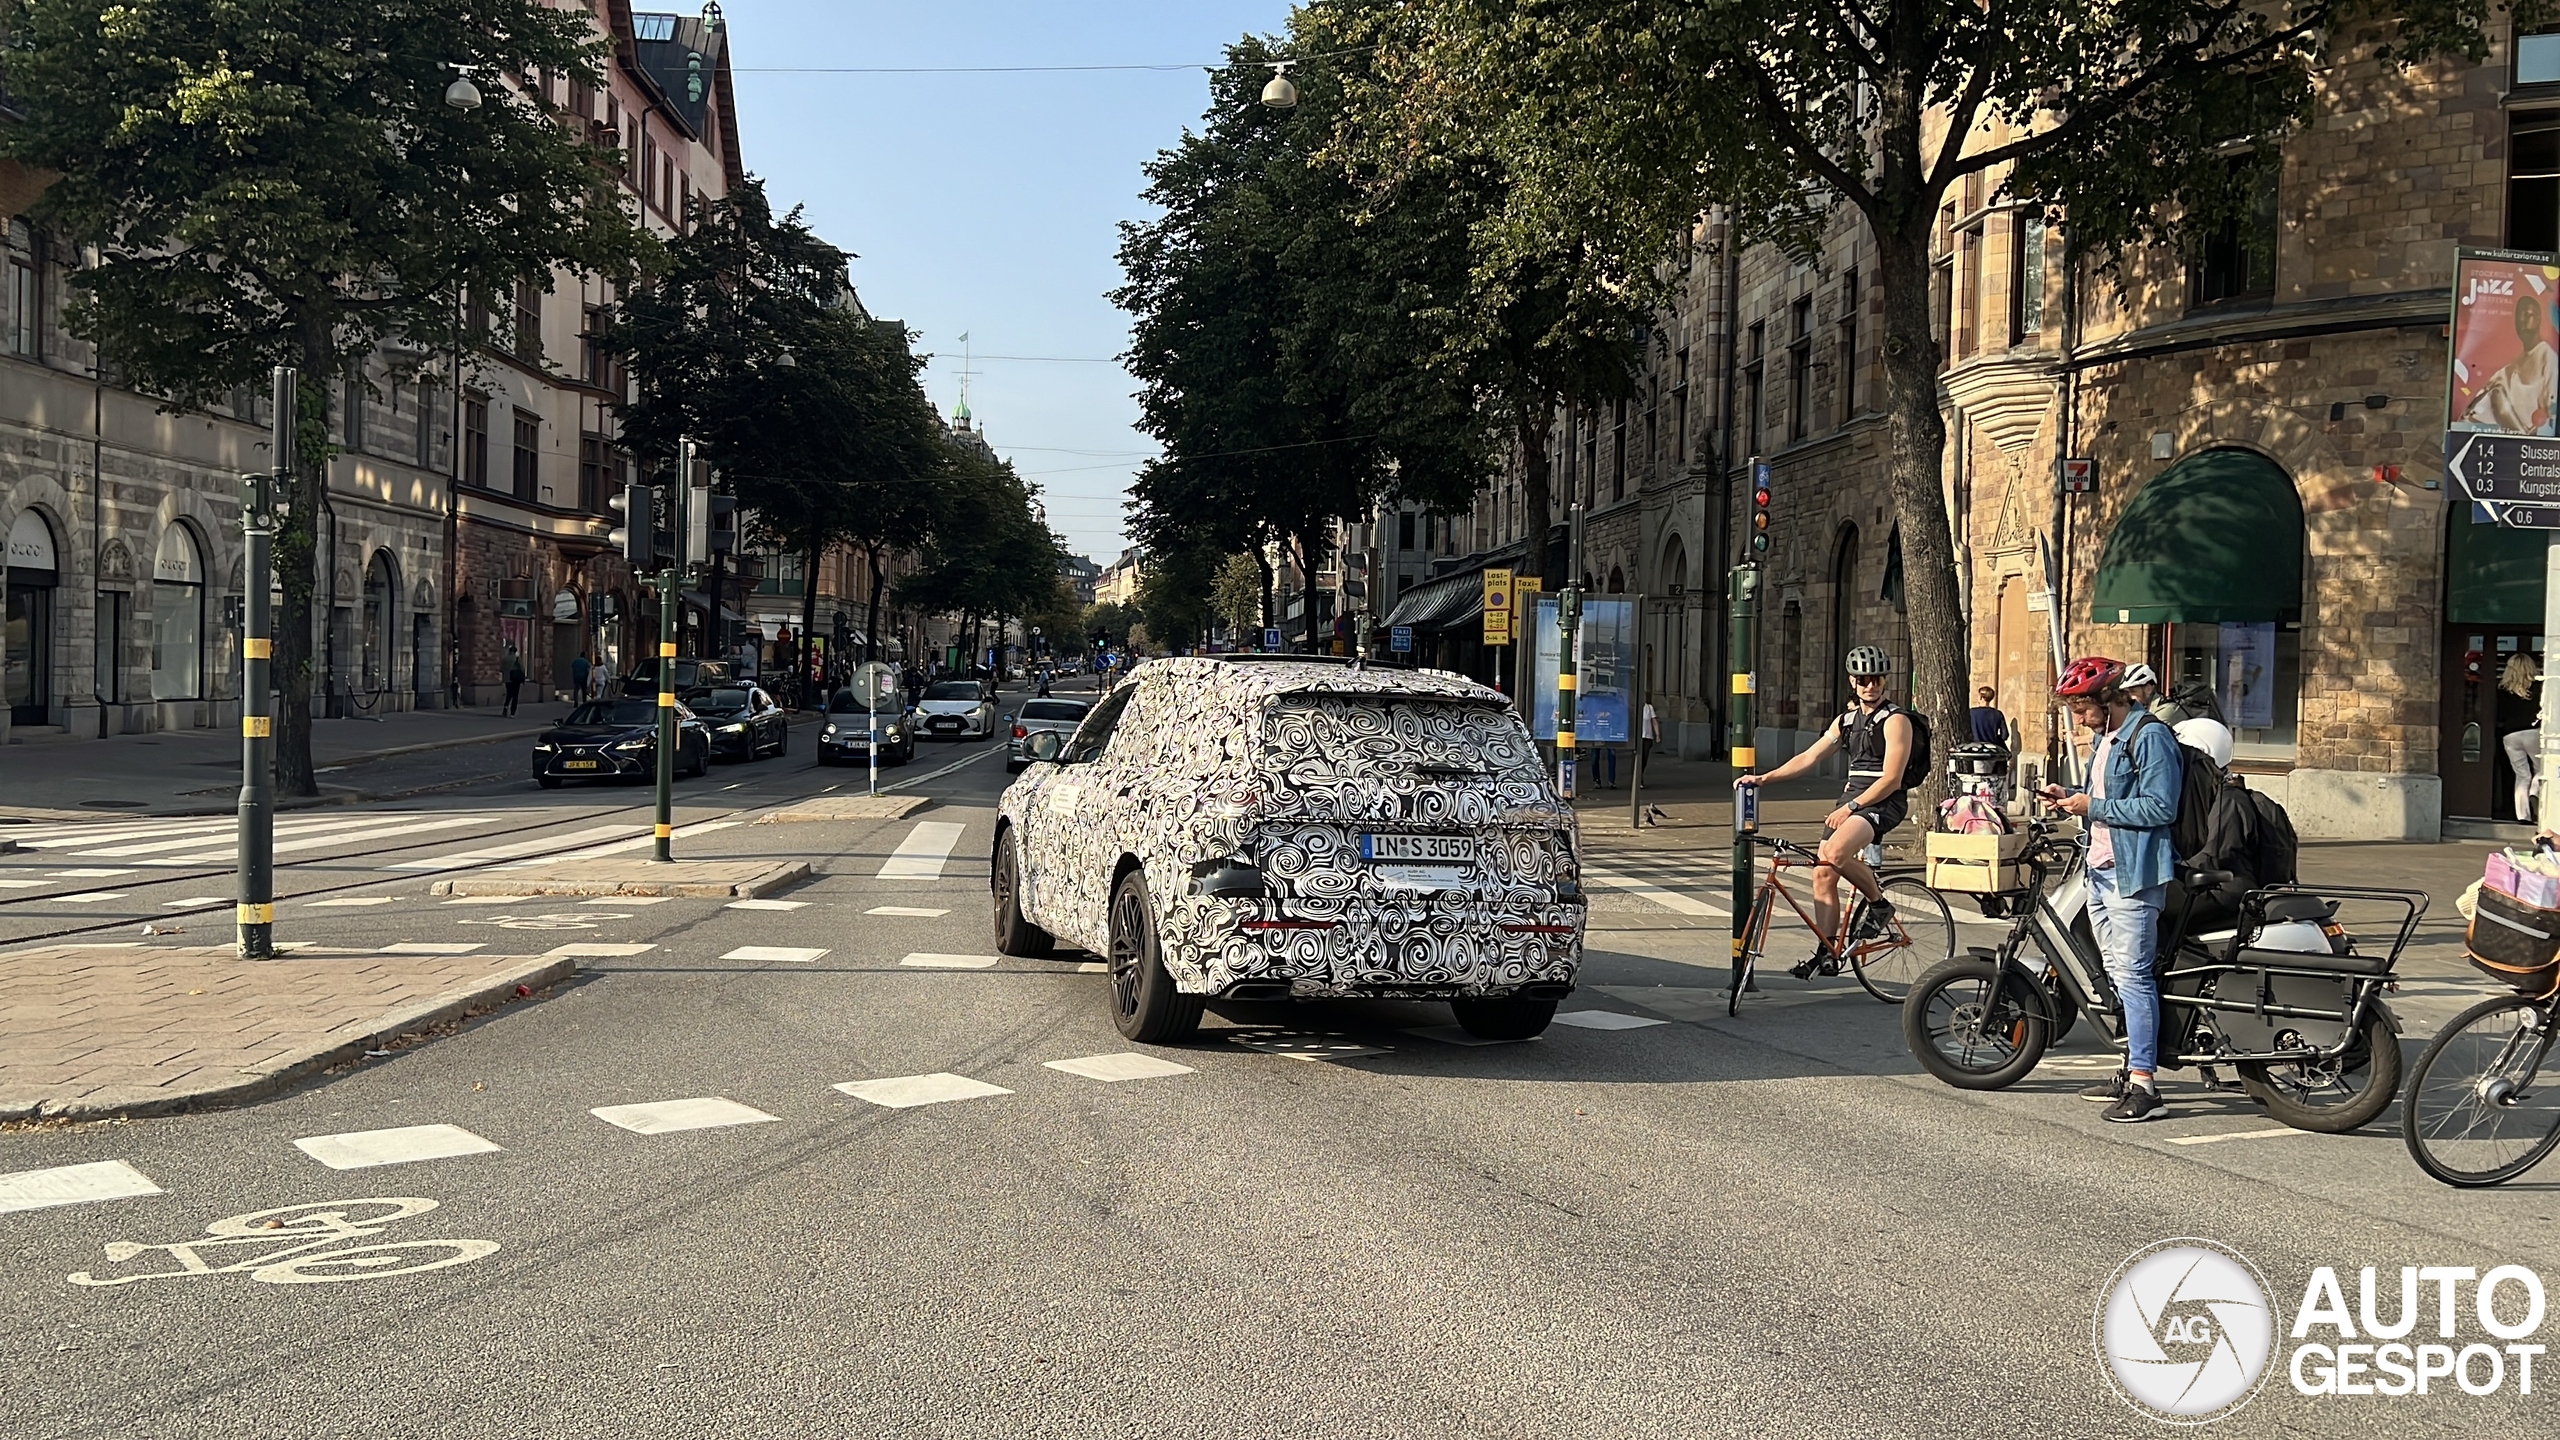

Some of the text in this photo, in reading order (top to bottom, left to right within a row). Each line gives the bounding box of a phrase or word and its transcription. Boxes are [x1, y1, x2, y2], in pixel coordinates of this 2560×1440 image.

[2477, 443, 2560, 460] 1,4 Slussen
[2477, 461, 2560, 478] 1,2 Centrals
[2476, 478, 2494, 494] 0,3
[1487, 580, 1508, 588] plats
[1517, 579, 1539, 587] Taxi-
[1675, 585, 1681, 595] 2
[1375, 837, 1472, 858] IN S 3059
